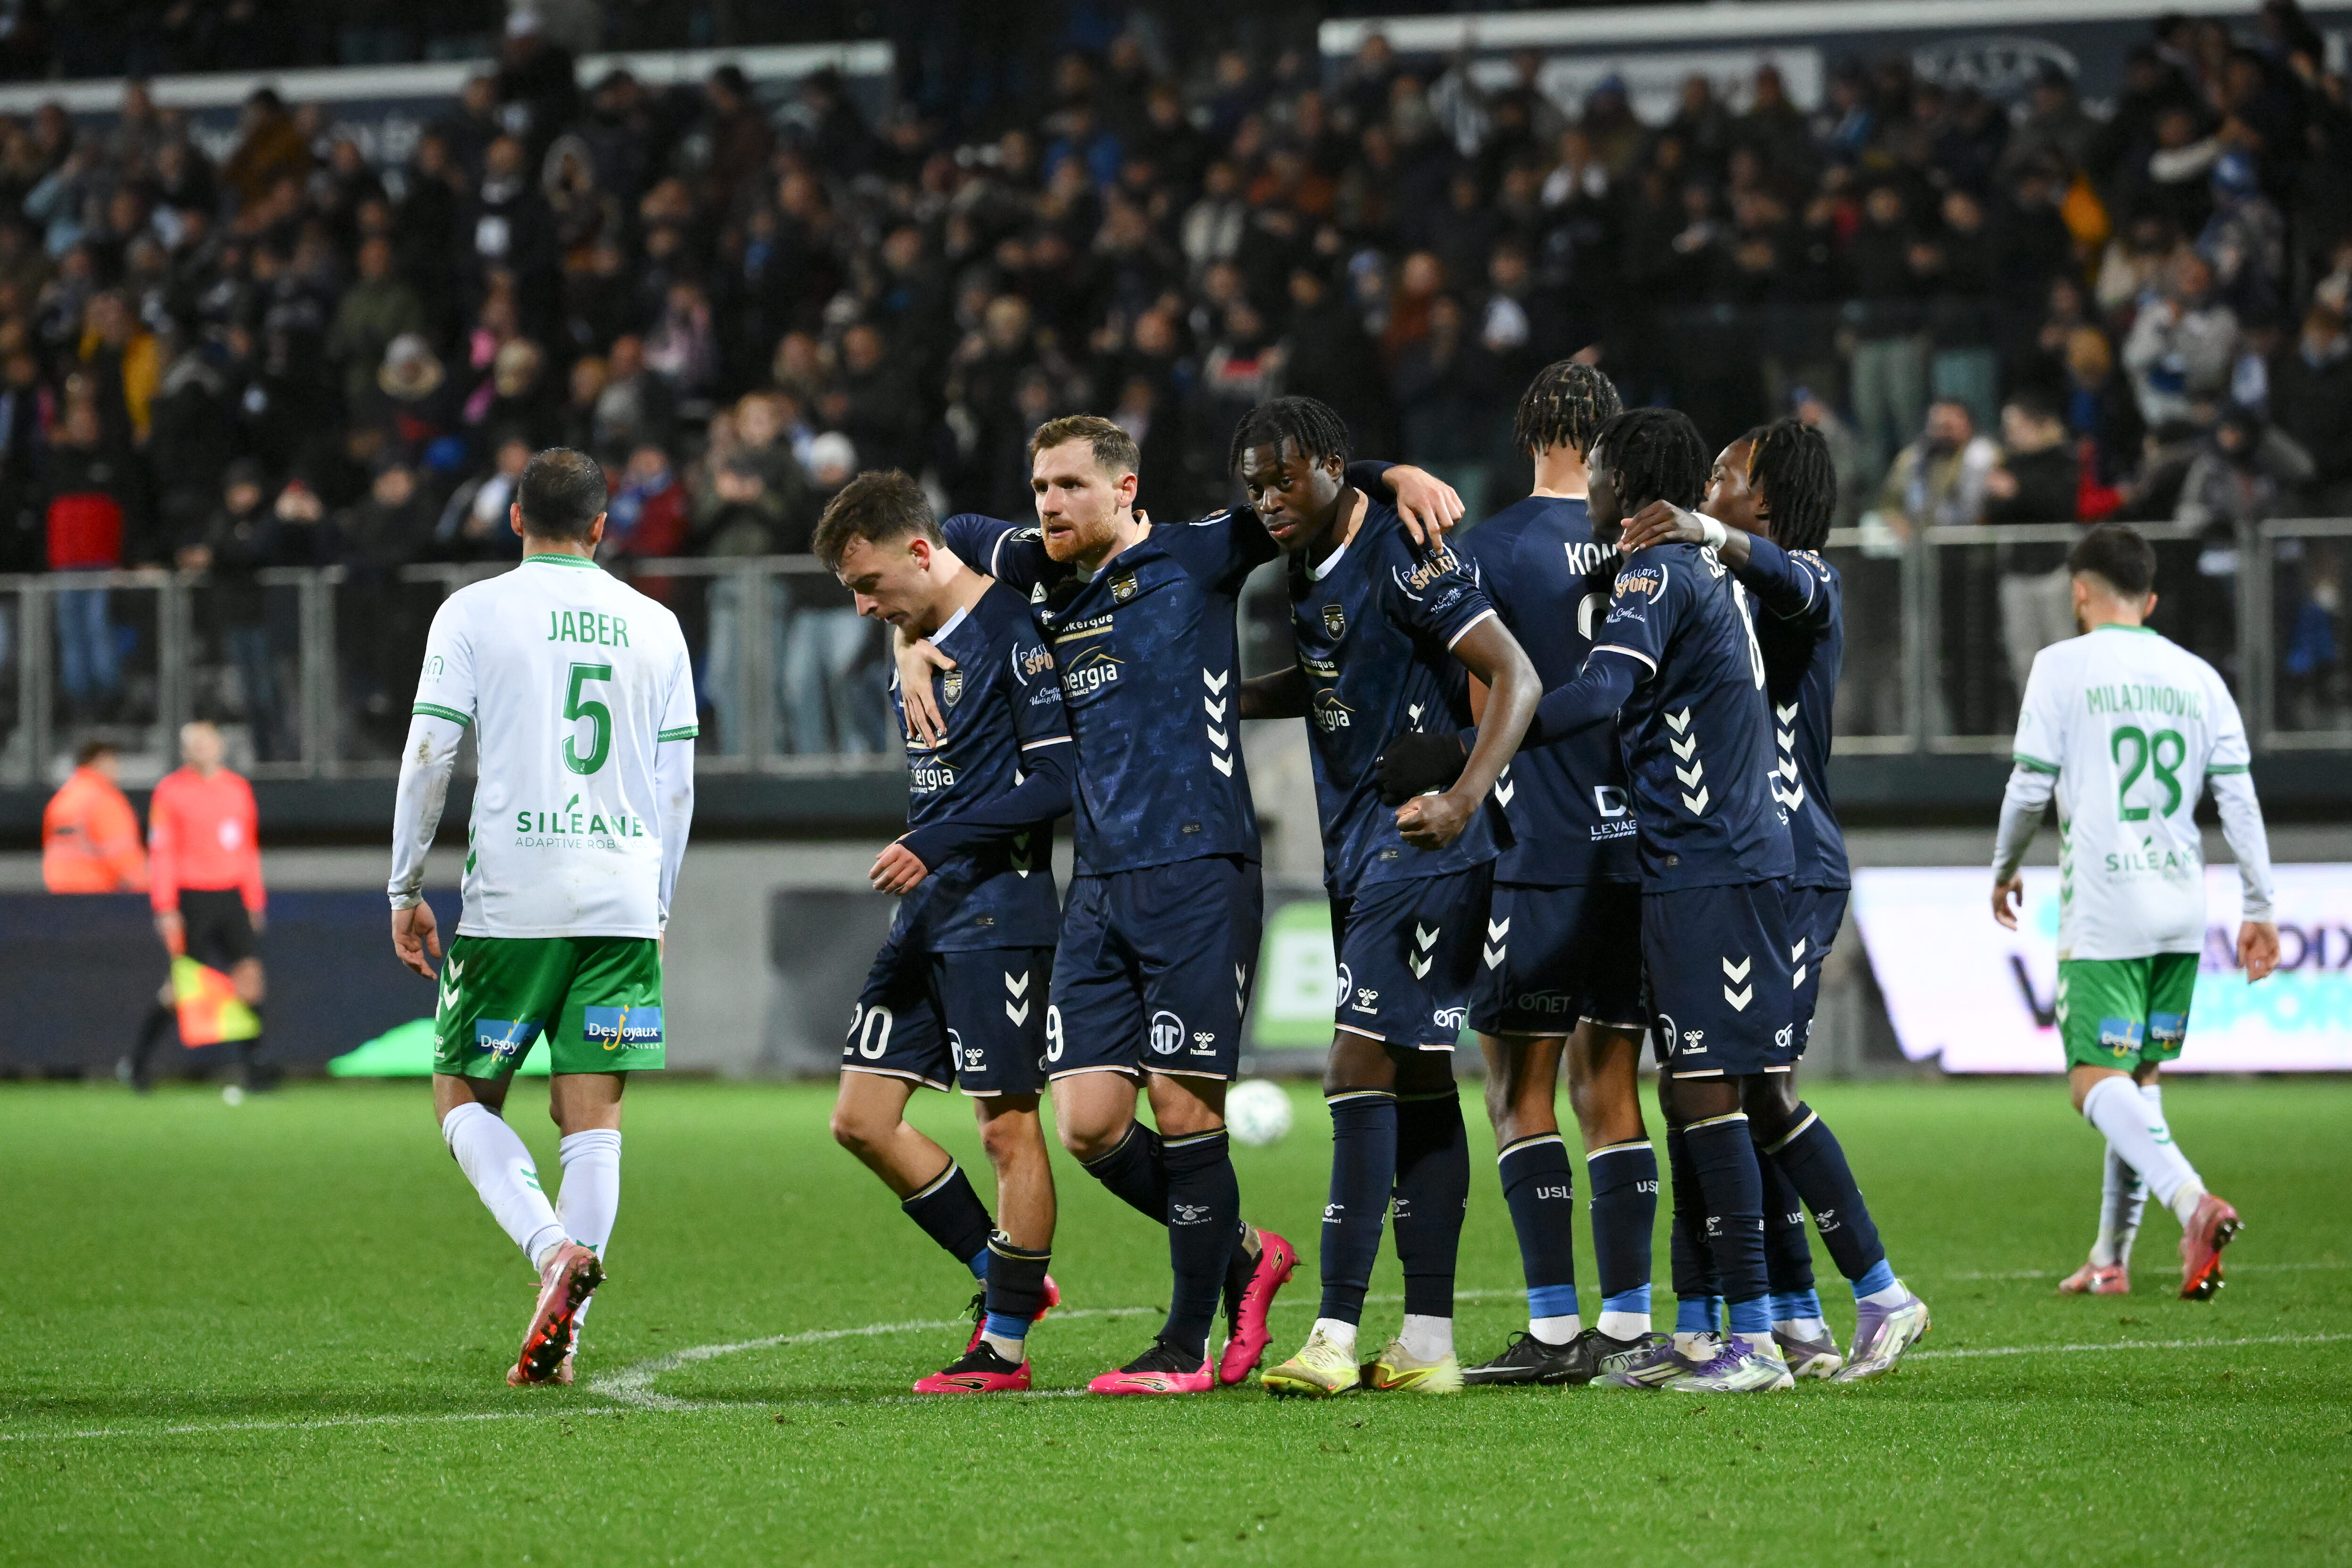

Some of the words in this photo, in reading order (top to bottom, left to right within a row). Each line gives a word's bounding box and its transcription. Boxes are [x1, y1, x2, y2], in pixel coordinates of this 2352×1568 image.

[1564, 542, 1619, 576] KON
[1615, 577, 1658, 598] SPORT
[548, 611, 629, 647] JABER
[1025, 653, 1054, 675] SPO
[562, 662, 612, 775] 5
[2111, 726, 2186, 821] 28
[1590, 820, 1637, 836] LEVAG
[515, 837, 582, 848] ADAPTIVE
[1352, 1003, 1378, 1015] hummel
[843, 1003, 893, 1060] 20
[1046, 1005, 1064, 1062] 9
[1190, 1047, 1216, 1056] hummel
[1682, 1045, 1707, 1055] hummel
[964, 1064, 987, 1072] hummel
